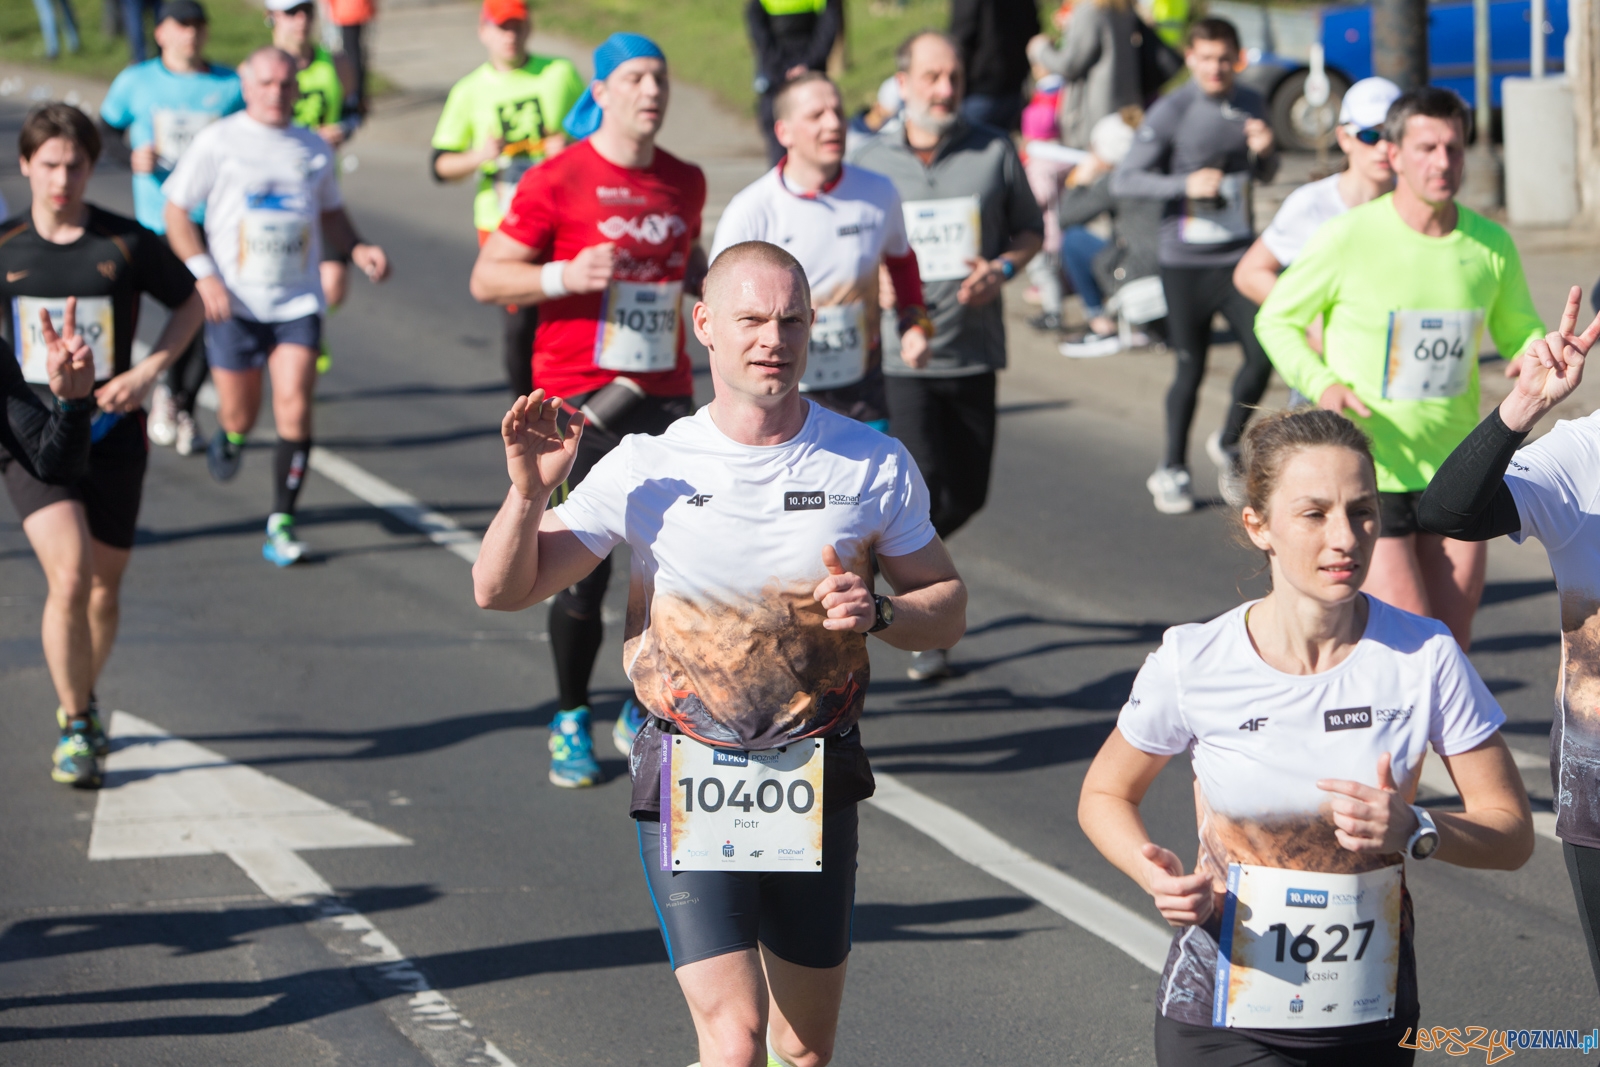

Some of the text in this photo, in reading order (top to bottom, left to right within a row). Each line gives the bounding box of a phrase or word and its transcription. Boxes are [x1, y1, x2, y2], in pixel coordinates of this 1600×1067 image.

[615, 308, 677, 334] 10378
[1413, 336, 1465, 361] 604
[686, 493, 714, 507] 4F
[787, 496, 823, 506] 10. PKO
[1238, 717, 1270, 732] 4F
[1328, 715, 1344, 727] 10.
[1345, 711, 1370, 724] PKO
[716, 753, 747, 763] 10. PKO
[677, 777, 816, 814] 10400
[734, 818, 760, 829] Piotr
[750, 849, 764, 858] 4F
[1289, 892, 1303, 904] 10.
[1303, 893, 1326, 905] PKO
[1268, 919, 1376, 965] 1627
[1303, 969, 1340, 982] Kasia
